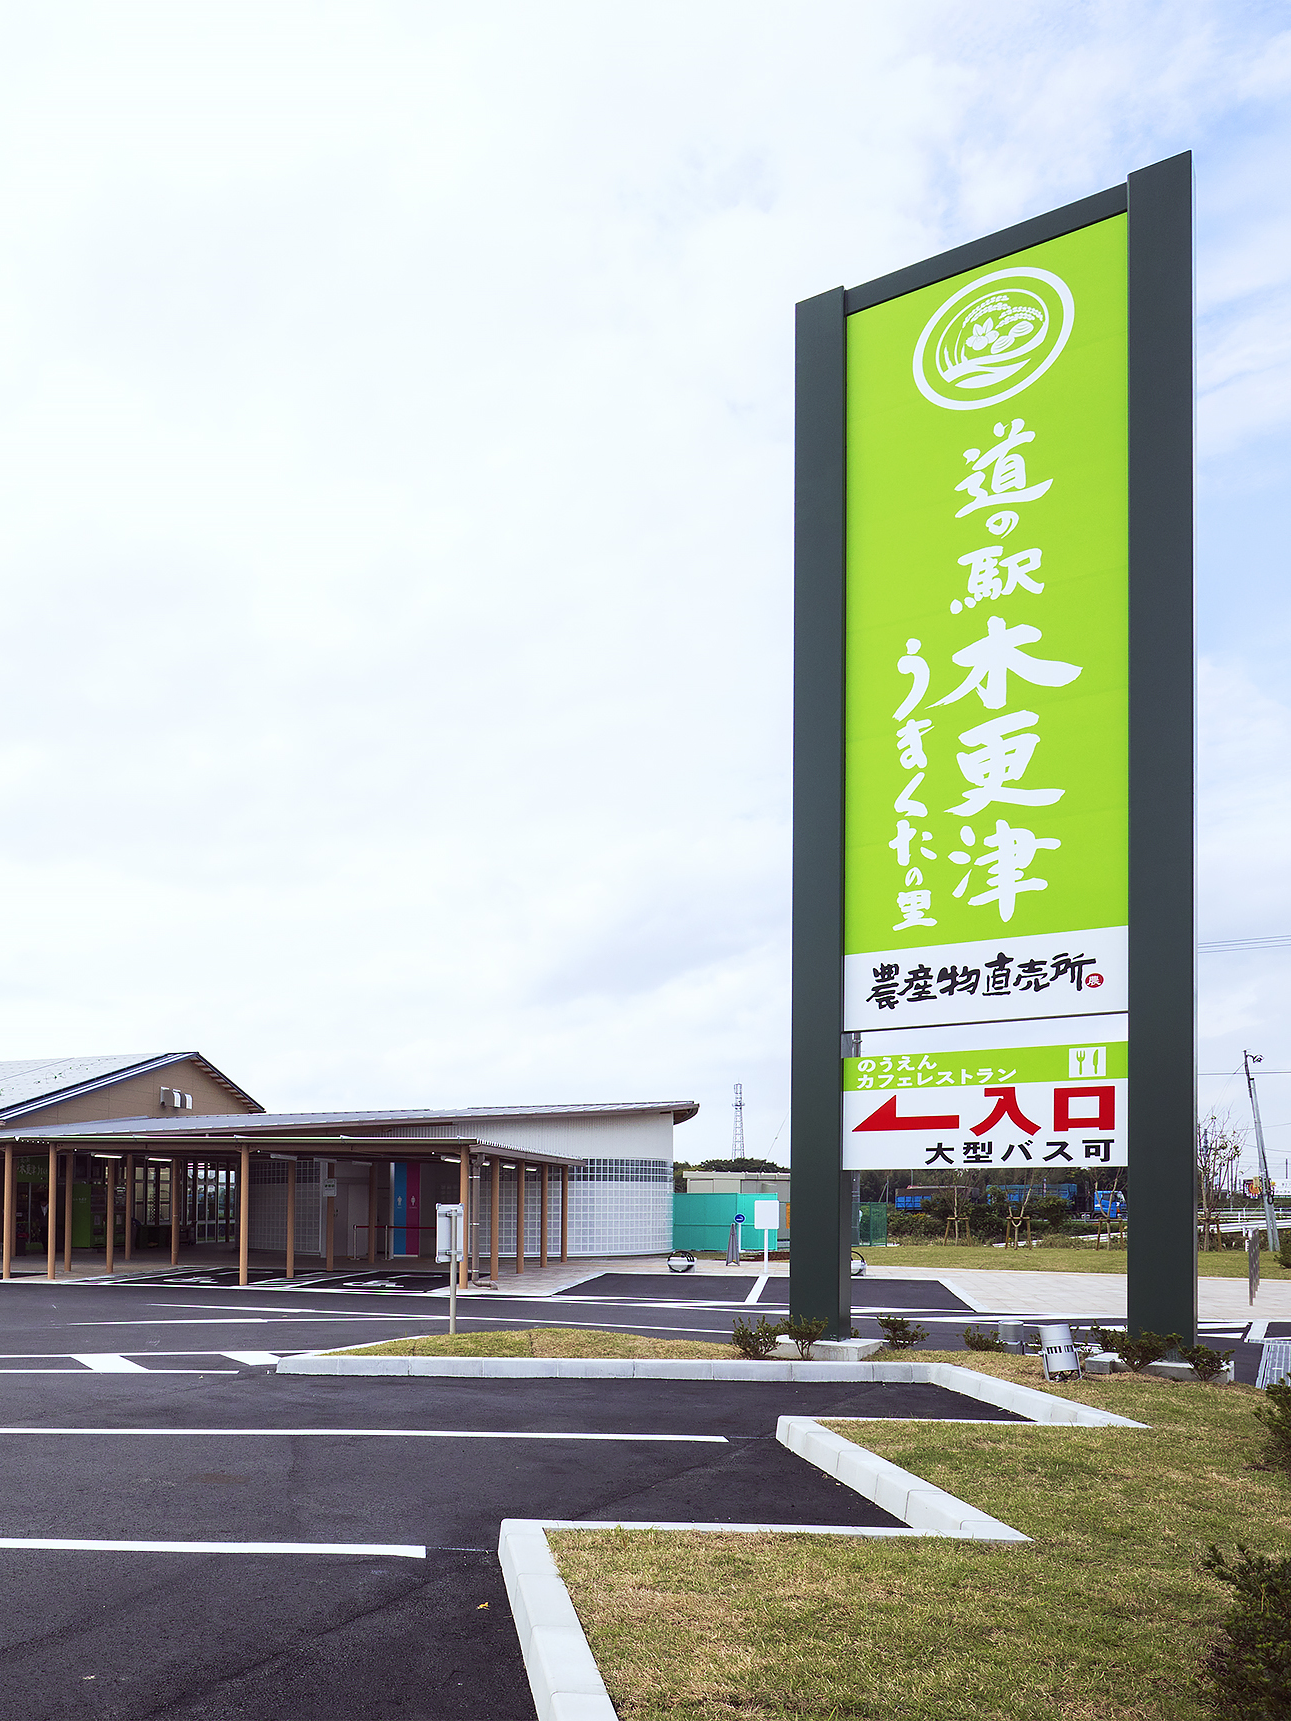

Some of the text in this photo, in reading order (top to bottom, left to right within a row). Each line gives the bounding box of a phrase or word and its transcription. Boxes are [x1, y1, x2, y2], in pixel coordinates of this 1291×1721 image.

[889, 638, 937, 931] うまくたの里
[866, 952, 1096, 1009] 農産物直売所
[857, 1055, 937, 1073] のうえん
[857, 1068, 1017, 1090] カフェレストラン
[969, 1086, 1115, 1137] 入口
[925, 1139, 1115, 1165] 大型バス可
